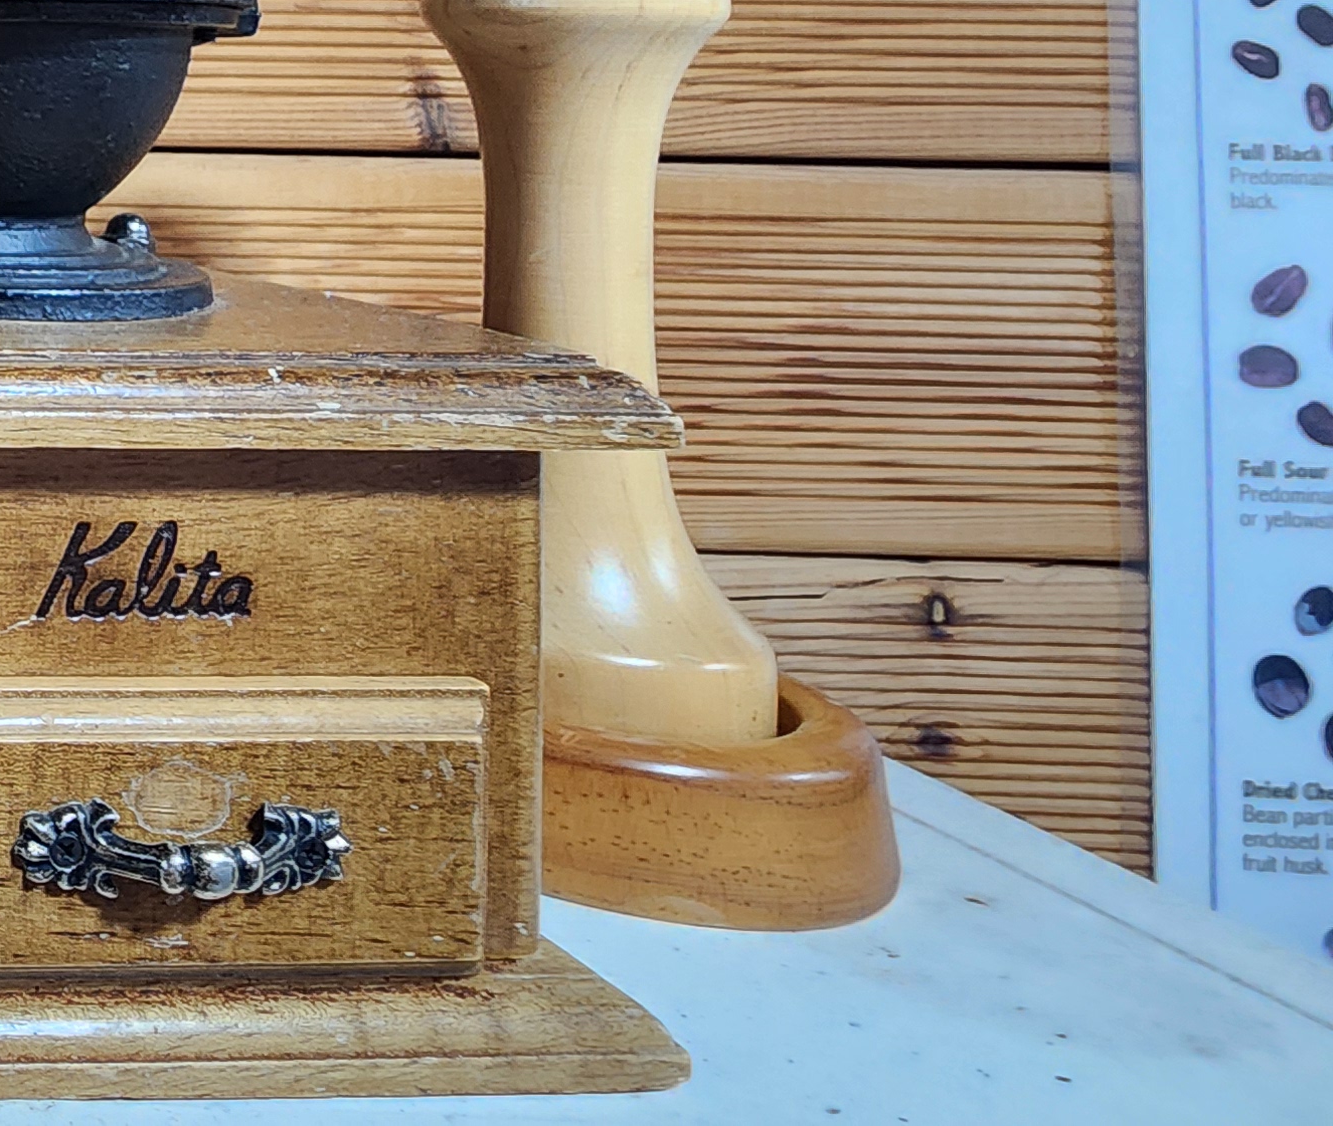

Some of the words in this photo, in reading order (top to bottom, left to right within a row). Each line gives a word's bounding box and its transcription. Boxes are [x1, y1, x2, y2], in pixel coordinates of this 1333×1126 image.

[1228, 142, 1264, 161] Full
[1273, 143, 1322, 162] Black
[1237, 459, 1276, 478] Full
[1282, 460, 1329, 479] Sour
[1239, 514, 1257, 527] or
[35, 520, 254, 621] Kalita
[1242, 779, 1298, 800] Dried
[1242, 803, 1287, 824] Bean
[1242, 832, 1318, 850] enclosed
[1242, 853, 1277, 872] fruit
